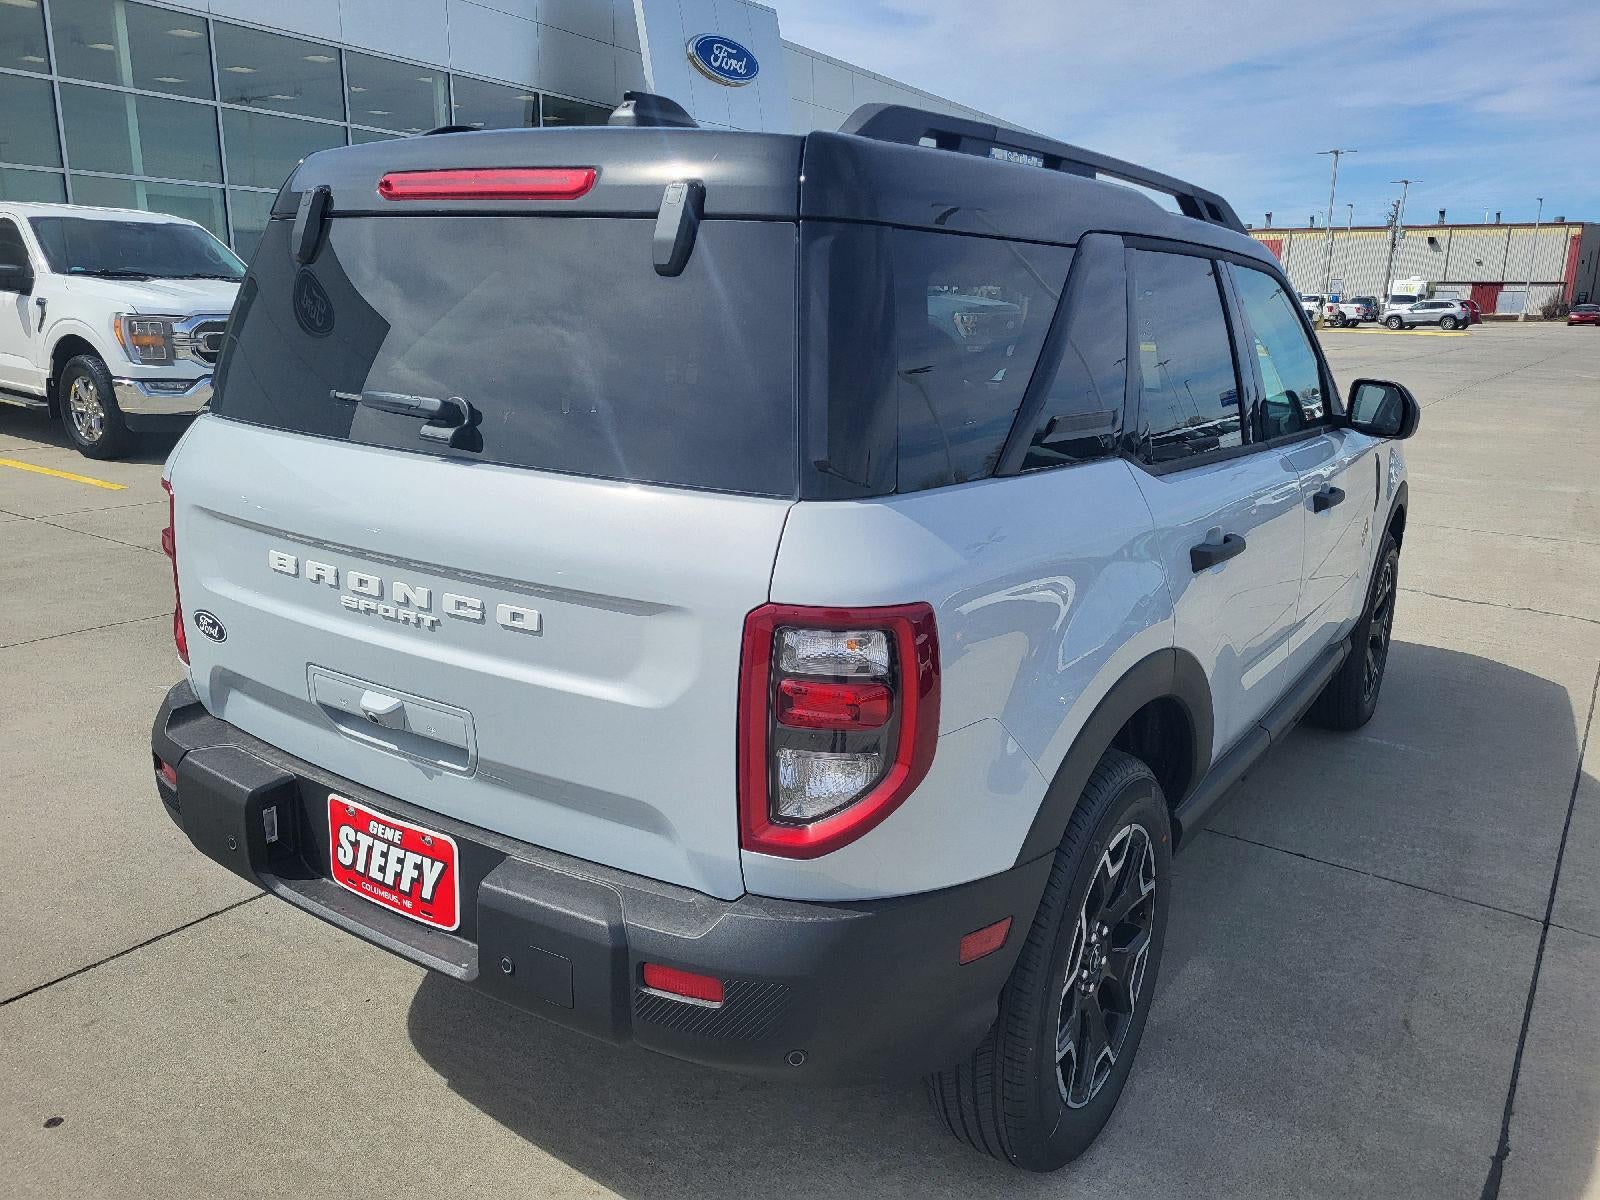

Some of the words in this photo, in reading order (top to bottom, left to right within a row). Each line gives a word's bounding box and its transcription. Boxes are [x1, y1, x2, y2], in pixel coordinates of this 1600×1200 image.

[711, 43, 747, 75] Ford
[269, 549, 542, 634] BRONCO
[199, 615, 219, 638] Ford
[340, 595, 441, 630] SPORT
[368, 820, 402, 844] GENE
[337, 824, 446, 902] STEFFY
[361, 881, 401, 906] COLUMBUS,
[402, 898, 413, 909] NE
